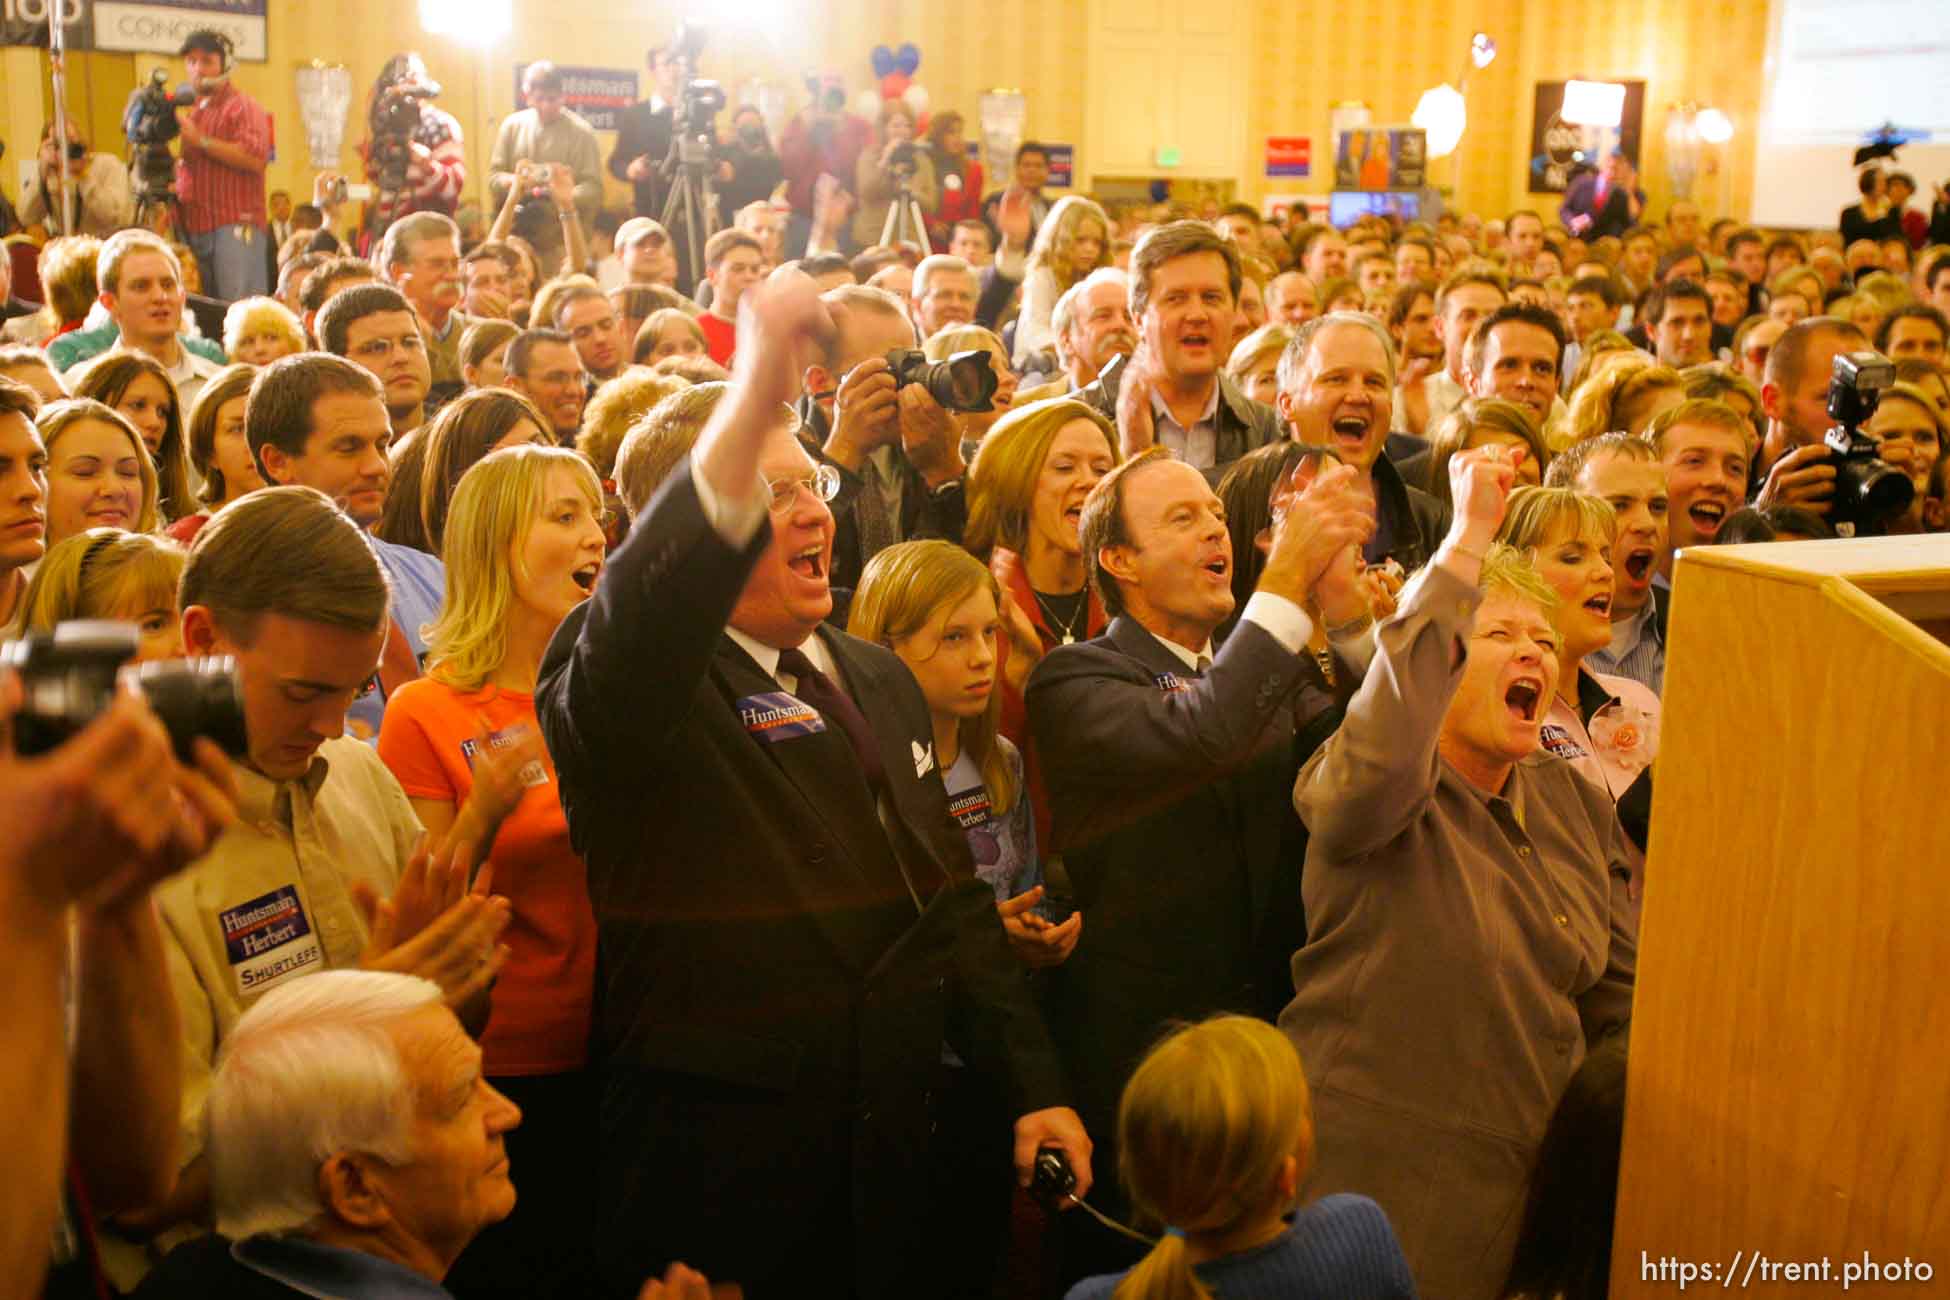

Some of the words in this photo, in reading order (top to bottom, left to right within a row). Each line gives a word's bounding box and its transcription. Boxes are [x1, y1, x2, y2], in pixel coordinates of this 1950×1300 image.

[117, 15, 244, 46] CONGS
[741, 705, 812, 727] Huntsma
[223, 897, 297, 932] Huntsman
[242, 925, 297, 956] Herbert
